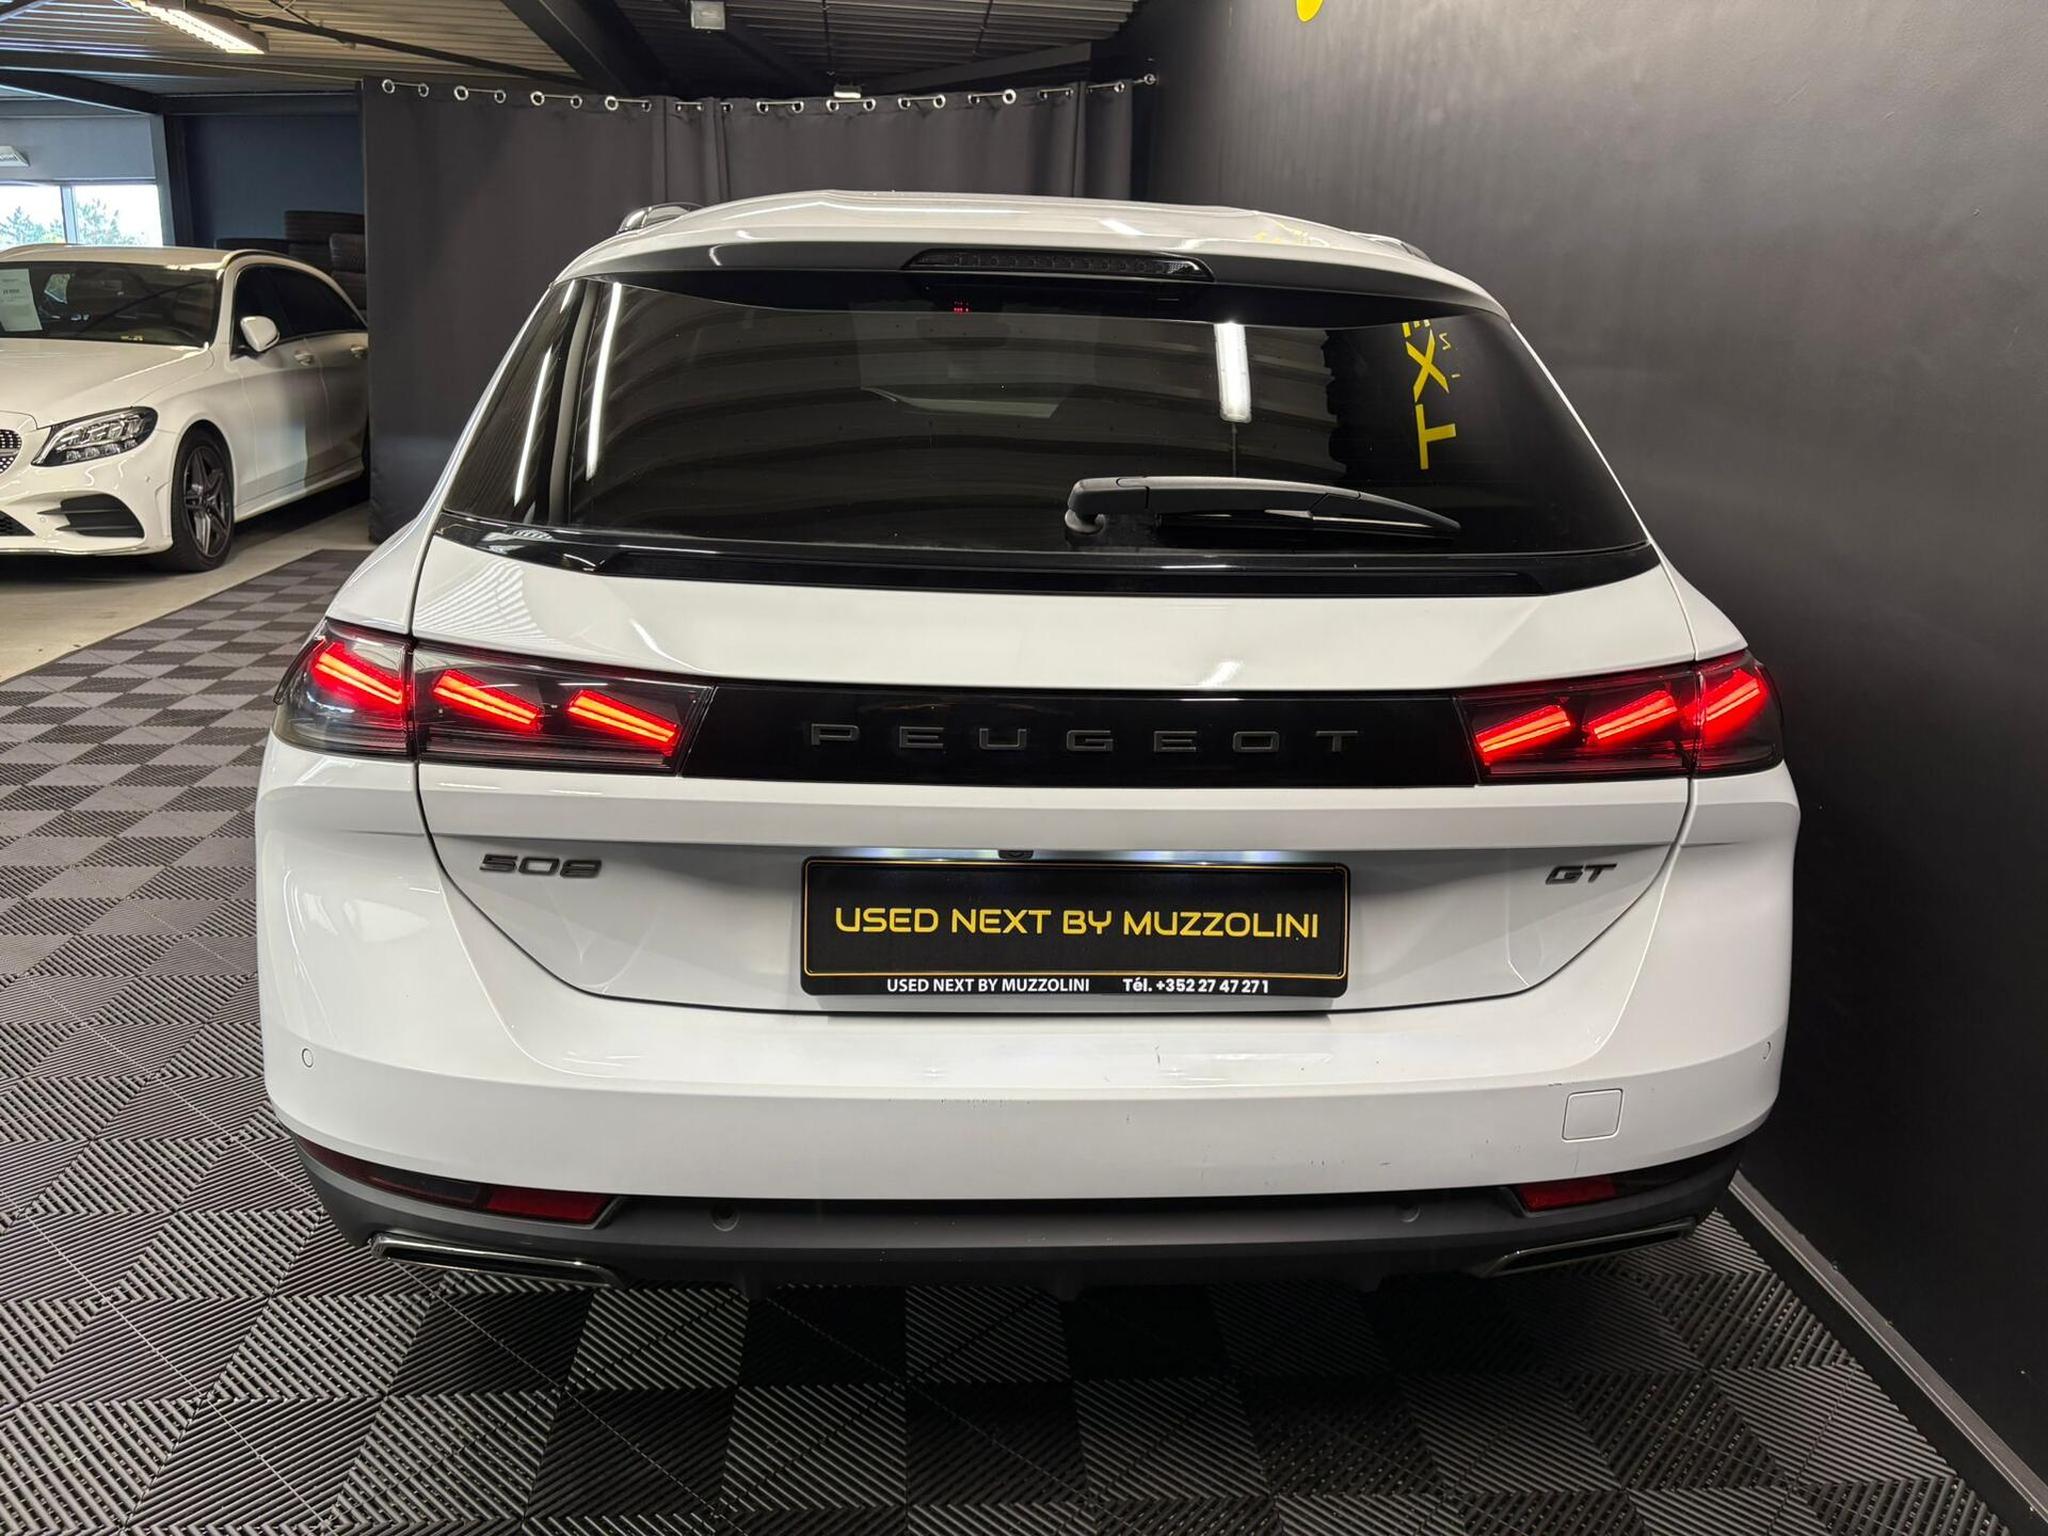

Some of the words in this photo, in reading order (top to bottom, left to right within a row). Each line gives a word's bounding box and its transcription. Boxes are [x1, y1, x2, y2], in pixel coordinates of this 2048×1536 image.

[810, 723, 1359, 753] PEUGEOT
[480, 854, 602, 878] 508
[1545, 864, 1617, 885] GT
[835, 907, 939, 933] USED
[951, 908, 1051, 934] NEXT
[1062, 909, 1112, 935] BY
[1123, 911, 1319, 939] MUZZOLINI
[887, 978, 930, 992] USED
[933, 978, 975, 992] NEXT
[978, 978, 999, 992] BY
[1001, 978, 1090, 992] MUZZOLINI
[1123, 977, 1153, 992] Tél.
[1156, 978, 1195, 992] +352
